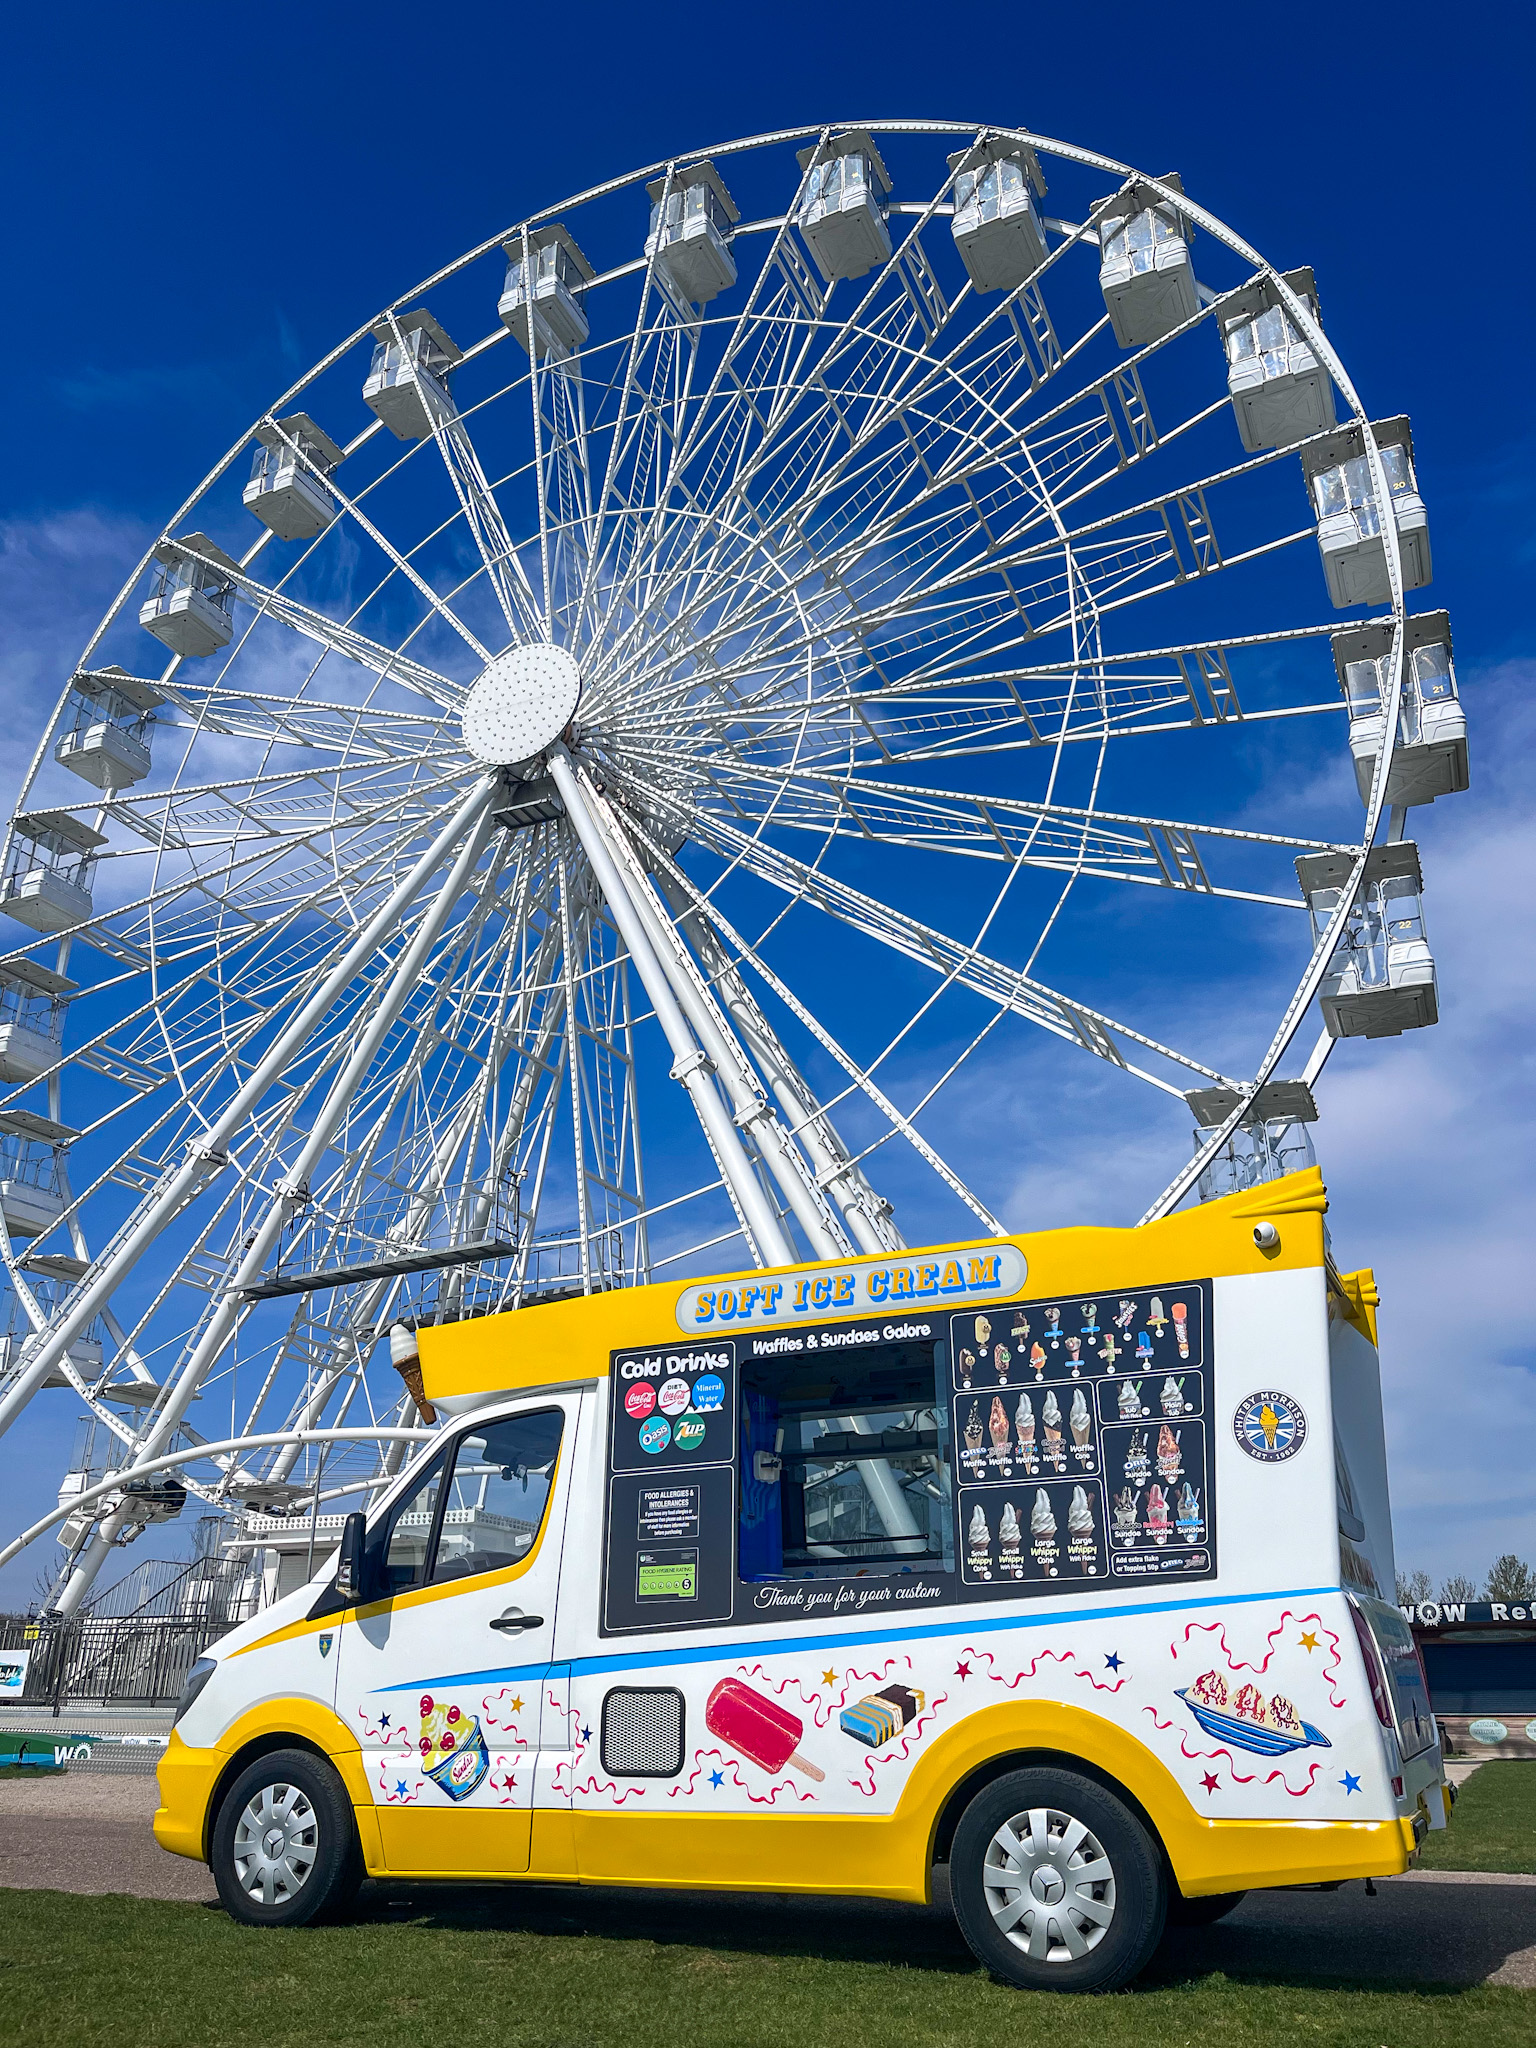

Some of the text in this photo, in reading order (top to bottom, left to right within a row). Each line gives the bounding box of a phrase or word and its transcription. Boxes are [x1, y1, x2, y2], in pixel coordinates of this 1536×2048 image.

[1393, 480, 1406, 491] 20
[1432, 684, 1444, 694] 21
[1398, 919, 1412, 930] 22
[695, 1254, 1001, 1323] SOFT ICE CREAM
[752, 1322, 932, 1355] Waffles & Sundaes Galore
[620, 1352, 730, 1379] Cold Drinks
[696, 1383, 722, 1392] Mineral
[698, 1395, 719, 1403] Water
[1124, 1406, 1137, 1414] Tub
[1163, 1402, 1182, 1410] Plain
[1235, 1392, 1305, 1441] WHITBY MORRISON
[642, 1424, 669, 1446] Oasis
[960, 1446, 987, 1459] OREO
[1070, 1445, 1095, 1453] Waffle
[1043, 1453, 1067, 1462] Waffle
[1075, 1452, 1090, 1460] Cone
[1251, 1448, 1268, 1460] EST
[963, 1459, 987, 1468] Waffle
[989, 1457, 1013, 1466] Waffle
[1015, 1456, 1040, 1465] Waffle
[1123, 1459, 1151, 1470] OREO
[1125, 1470, 1152, 1479] Sundae
[1157, 1468, 1185, 1476] Sundae
[644, 1492, 660, 1500] FOOD
[660, 1489, 689, 1498] ALLERGIES
[649, 1499, 689, 1508] INTOLERANCES
[1114, 1530, 1142, 1538] Sundae
[1146, 1528, 1174, 1536] Sundae
[1177, 1526, 1205, 1534] Sundae
[1034, 1539, 1056, 1548] Large
[1071, 1537, 1093, 1545] Large
[971, 1549, 988, 1557] Small
[1030, 1547, 1060, 1557] Whippy
[1067, 1545, 1097, 1555] Whippy
[967, 1557, 993, 1566] Whippy
[998, 1555, 1025, 1564] Whippy
[1037, 1556, 1055, 1564] Cone
[1116, 1556, 1128, 1564] Add
[1160, 1559, 1183, 1569] OREO
[1124, 1564, 1147, 1573] Topping
[683, 1579, 690, 1589] 5
[753, 1581, 942, 1612] Thank you for your custom
